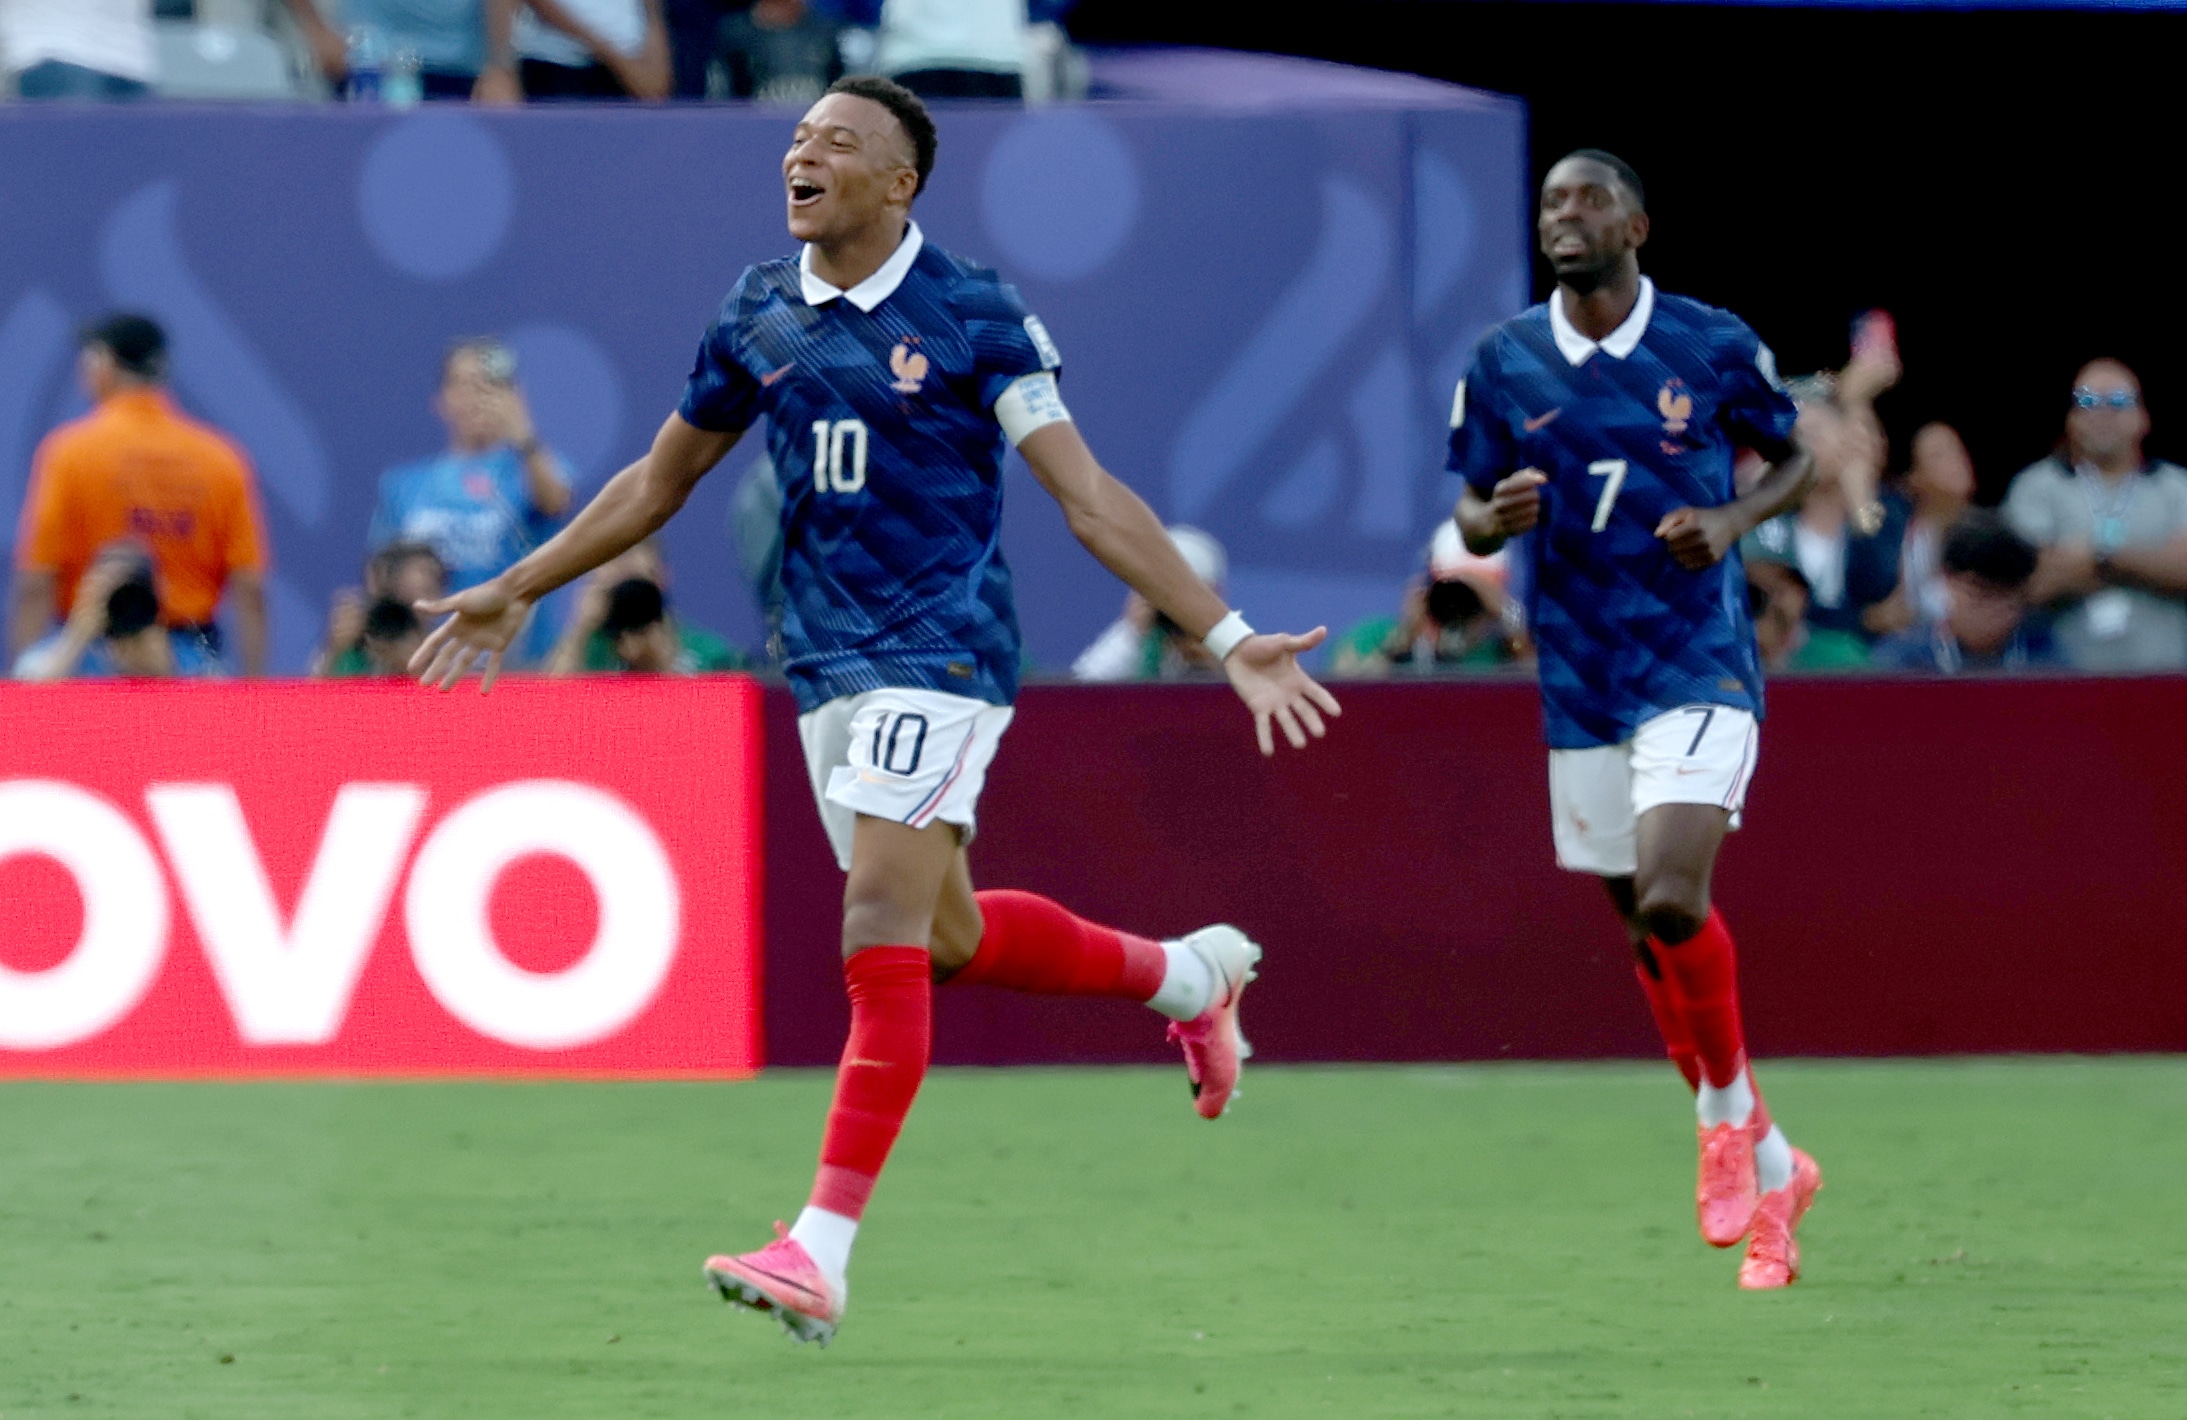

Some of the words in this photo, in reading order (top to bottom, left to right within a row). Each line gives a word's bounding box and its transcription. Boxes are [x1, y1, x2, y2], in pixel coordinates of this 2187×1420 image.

[812, 419, 867, 494] 10
[1588, 459, 1627, 533] 7
[873, 712, 928, 776] 10
[1685, 708, 1715, 756] 7
[0, 777, 682, 1050] OVO
